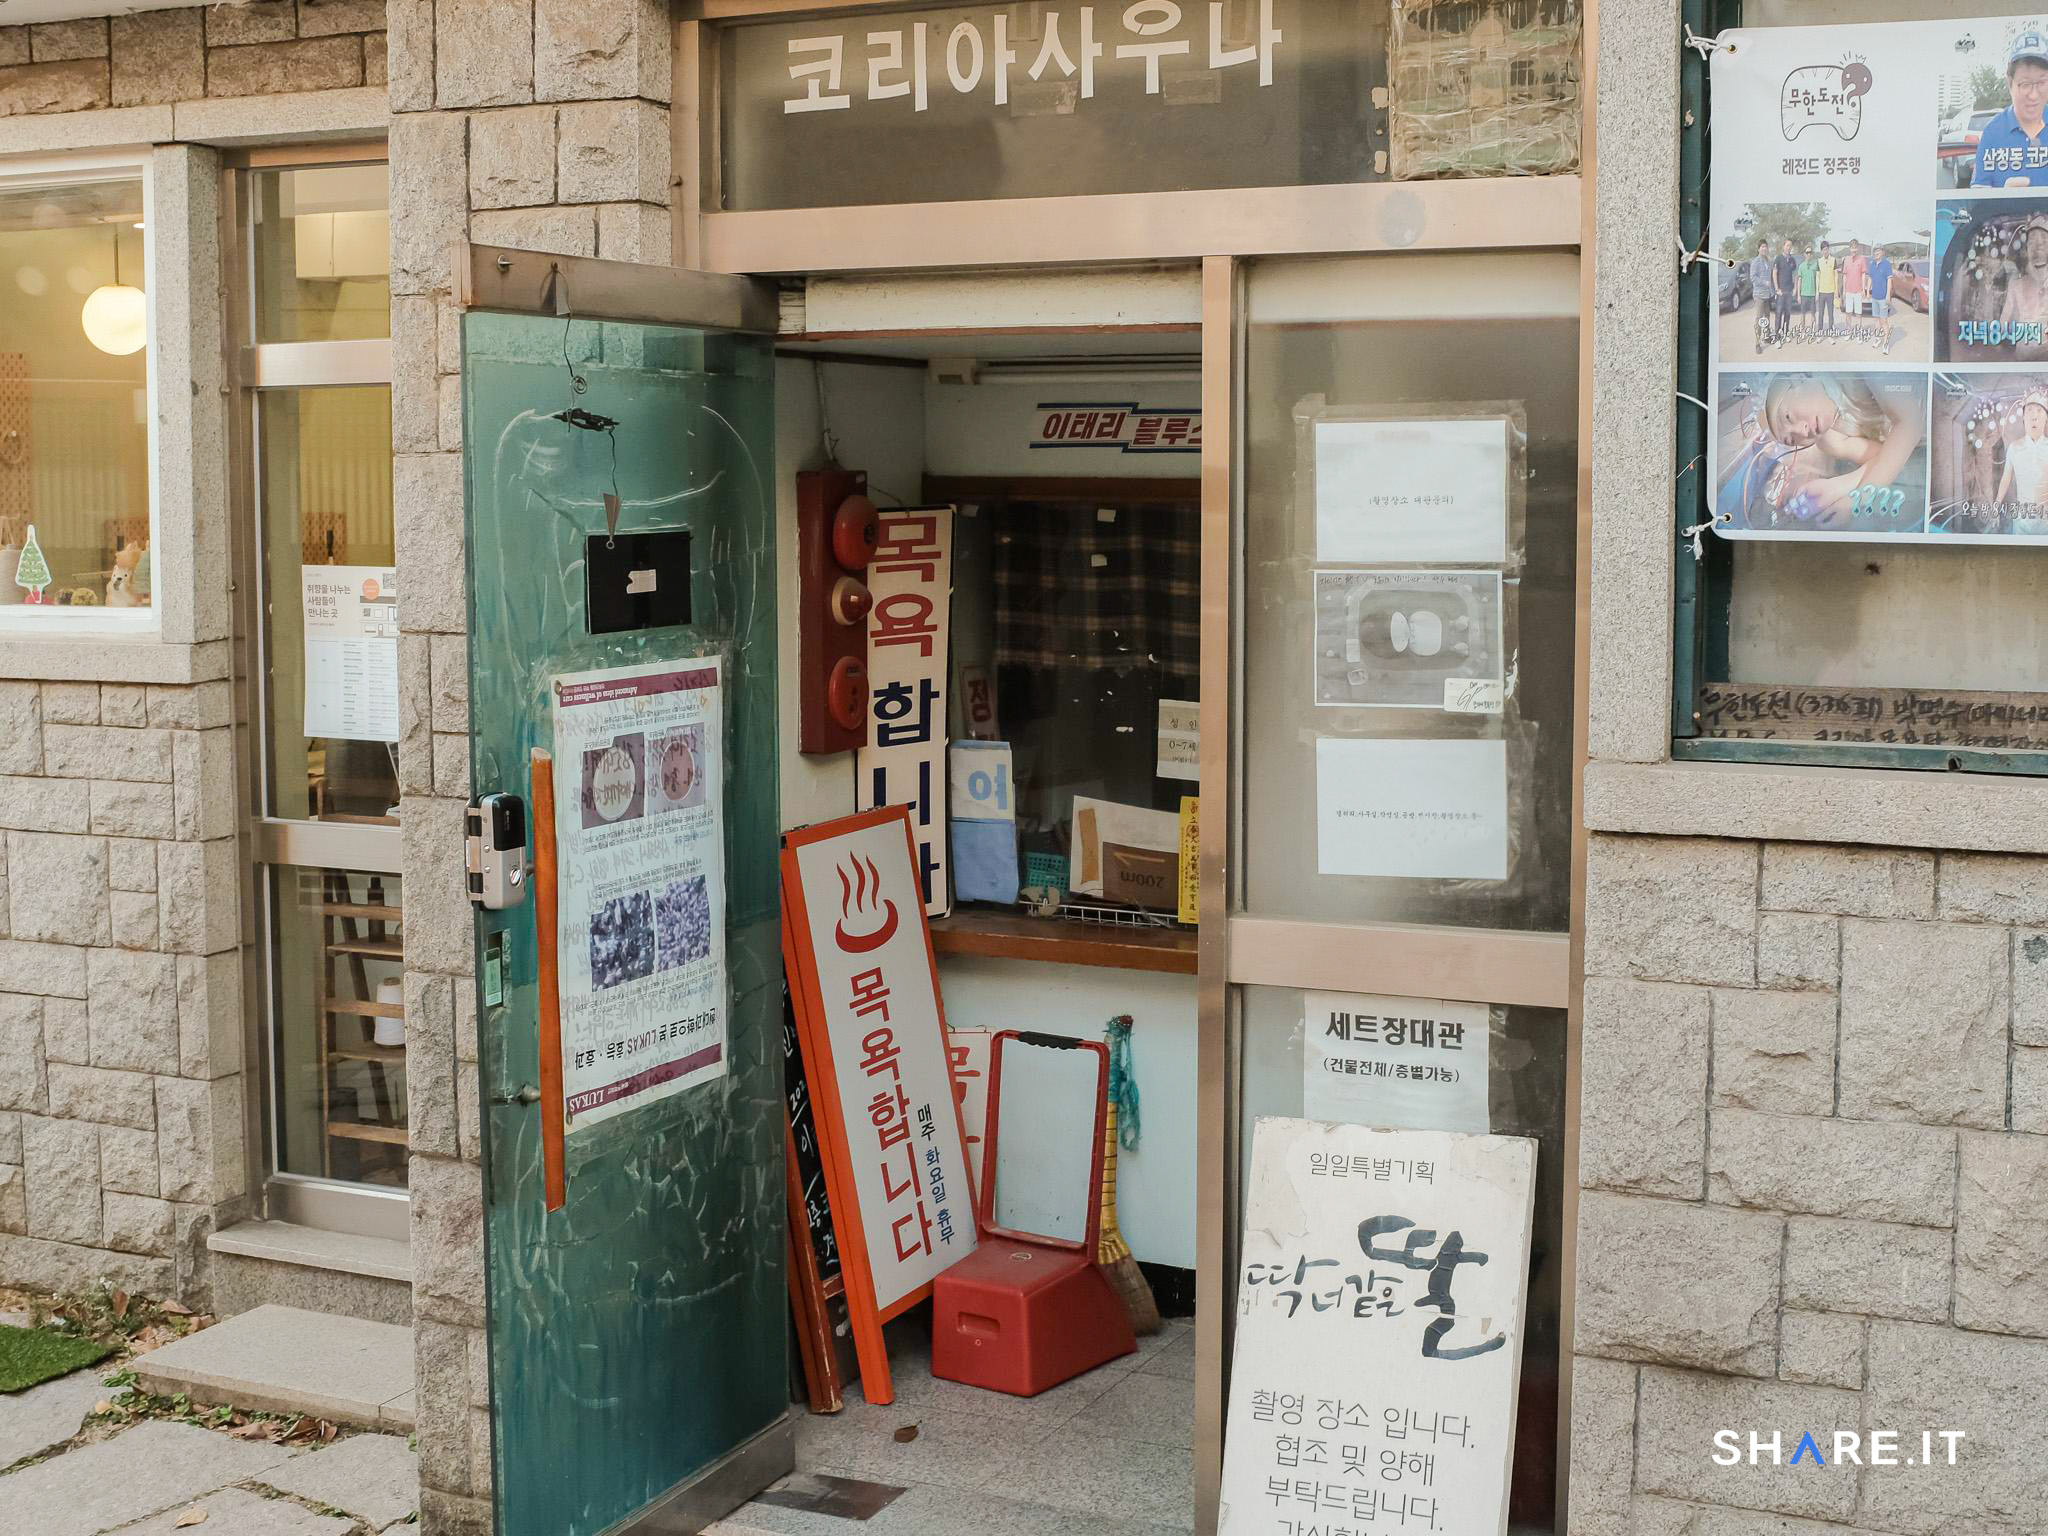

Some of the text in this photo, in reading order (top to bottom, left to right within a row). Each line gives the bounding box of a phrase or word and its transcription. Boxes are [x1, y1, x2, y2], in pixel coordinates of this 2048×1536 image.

[784, 0, 1282, 114] 코리아사우나
[1782, 156, 1861, 176] 레전드 정주행
[1983, 147, 2024, 171] 삼청동
[1043, 412, 1127, 440] 이태리
[330, 584, 351, 595] 나누는
[627, 1028, 657, 1055] LUKAS
[1325, 1011, 1465, 1050] 세트장대관
[1323, 1057, 1460, 1083] (건물전체/층별가능)
[569, 1090, 604, 1113] LUKAS
[849, 966, 933, 1264] 목욕합니다
[917, 1104, 955, 1245] 매주 화요일 휴무
[1310, 1153, 1435, 1185] 일일특별기획
[1357, 1215, 1506, 1361] 딸
[1252, 1389, 1475, 1449] 촬영 장소 입니다.
[1276, 1433, 1435, 1487] 협조 및 양해
[1265, 1475, 1443, 1531] 부탁드립니다.
